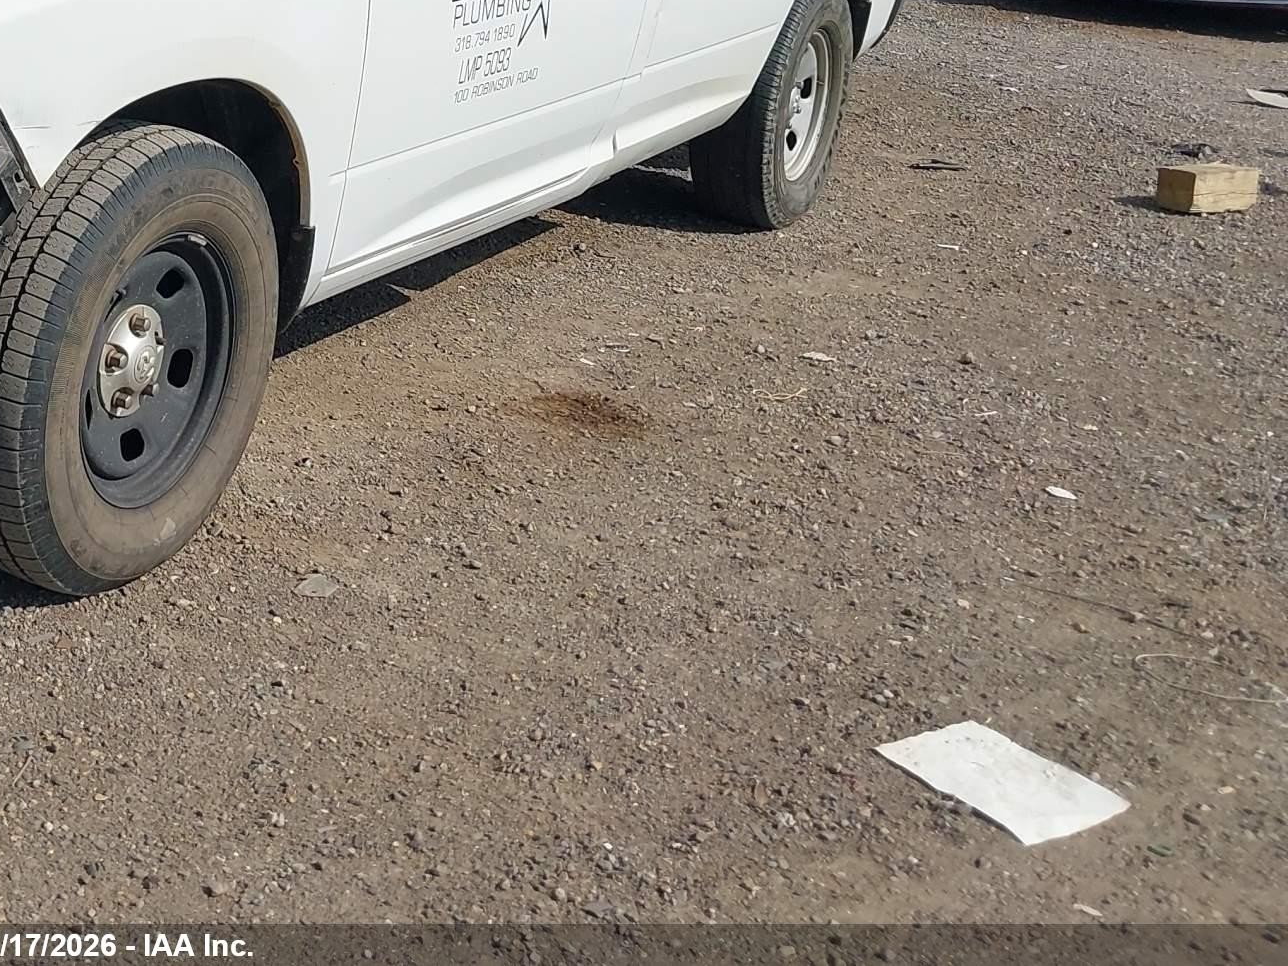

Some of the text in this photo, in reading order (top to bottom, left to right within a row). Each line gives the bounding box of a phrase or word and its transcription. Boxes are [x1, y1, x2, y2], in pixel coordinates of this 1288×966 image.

[493, 23, 516, 42] 1890
[458, 47, 512, 84] LMP 5093
[454, 67, 539, 103] 100 ROBINSON ROAD
